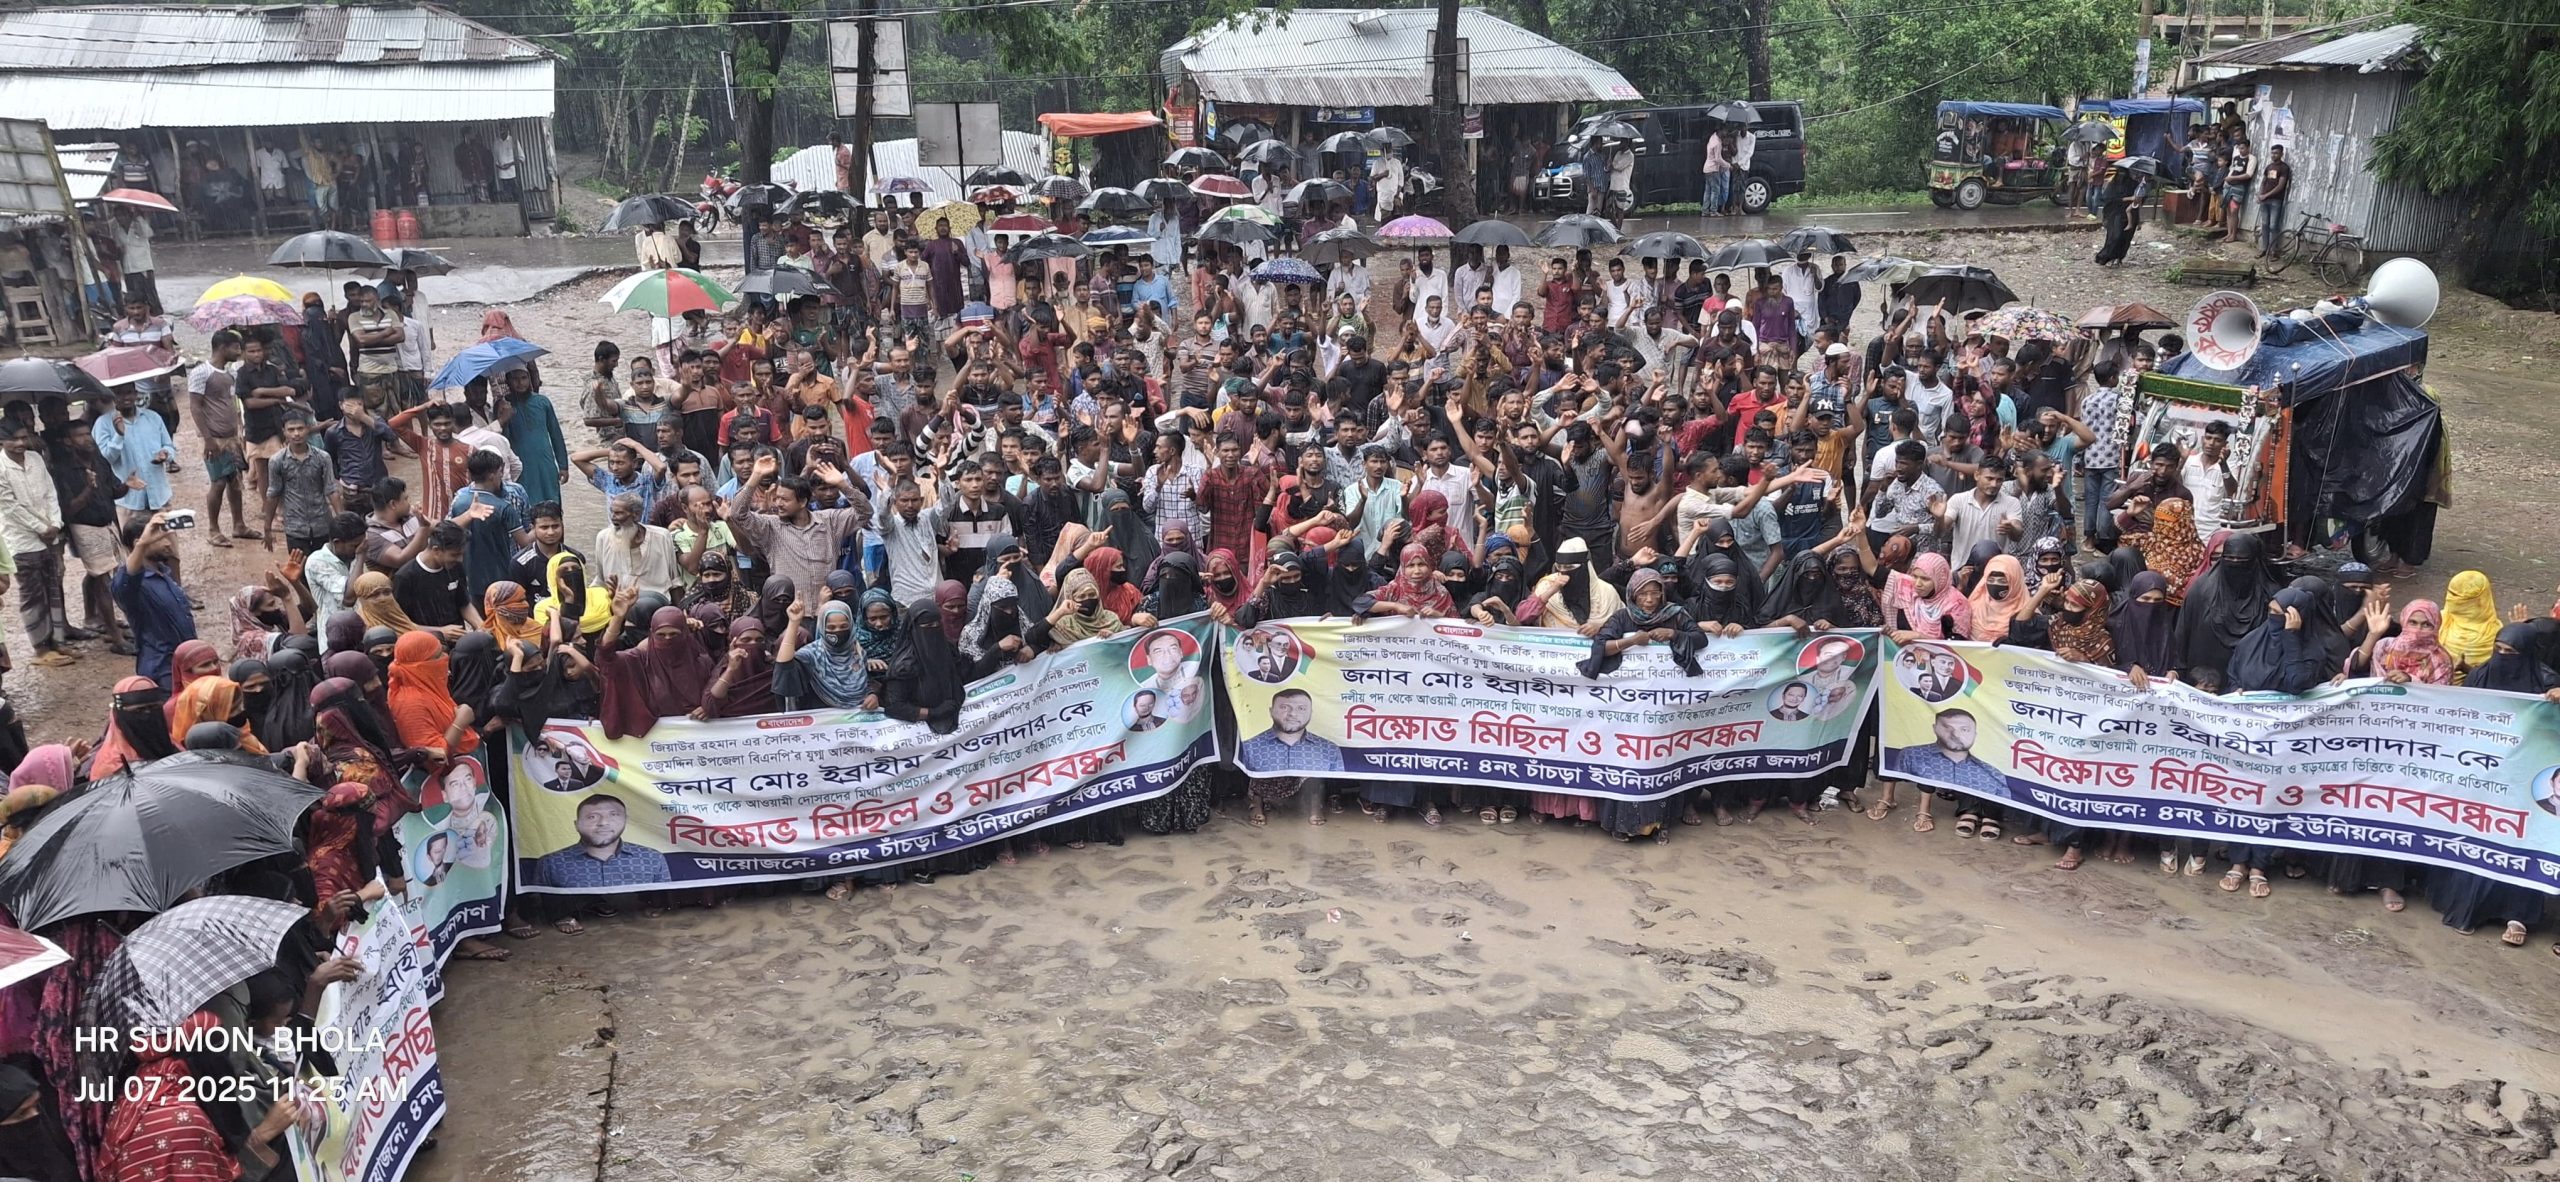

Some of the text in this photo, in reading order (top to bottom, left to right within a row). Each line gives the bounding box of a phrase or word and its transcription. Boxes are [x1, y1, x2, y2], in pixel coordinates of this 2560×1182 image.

[1381, 648, 1421, 661] উপজেলা
[1384, 635, 1416, 645] রহমান
[1420, 638, 1437, 647] এর
[1439, 637, 1473, 653] সৈনিক,
[650, 740, 695, 753] জিয়াউর
[700, 739, 737, 750] রহমান
[742, 737, 761, 747] এর
[764, 732, 806, 745] সৈনিক,
[835, 726, 873, 740] নির্ভীক,
[1067, 661, 1088, 676] কর্মী
[1340, 667, 1413, 686] জনাব
[1422, 671, 1473, 689] মোঃ
[1482, 672, 1579, 698] ইব্রাহীম
[1341, 689, 1365, 703] দলীয়
[1369, 693, 1385, 703] পদ
[1388, 692, 1414, 704] থেকে
[1415, 692, 1458, 707] আওয়ামী
[1461, 697, 1508, 711] দোসরদের
[1511, 699, 1536, 714] মিথ্যা
[1539, 702, 1582, 718] অপপ্রচার
[1586, 710, 1594, 718] ও
[2004, 679, 2051, 694] তজুমদ্দিন
[2055, 685, 2100, 704] উপজেলা
[2233, 717, 2241, 727] ও
[2308, 714, 2354, 728] ইউনিয়ন
[2359, 713, 2417, 730] বিএনপি'র
[2421, 722, 2466, 736] সাধারণ
[2469, 727, 2521, 746] সম্পাদক
[2013, 665, 2055, 680] জিয়াউর
[2059, 675, 2095, 688] রহমান
[2099, 683, 2118, 692] এর
[2370, 701, 2429, 714] দুঃসময়ের
[2485, 712, 2514, 726] কর্মী
[642, 756, 694, 773] তজুমদ্দিন
[697, 754, 745, 767] উপজেলা
[806, 749, 825, 763] যুগ্ম
[880, 744, 889, 752] ও
[893, 739, 915, 751] ৪নং
[1060, 677, 1100, 693] সম্পাদক
[652, 700, 1095, 796] জনাব মোঃ ইব্রাহীম হাওলাদার-কে
[1344, 704, 1764, 761] বিক্ষোভ মিছিল ও মানববন্ধন
[2007, 722, 2034, 739] দলীয়
[2038, 730, 2055, 742] পদ
[2058, 734, 2086, 749] থেকে
[2090, 738, 2138, 753] আওয়ামী
[2142, 743, 2197, 760] দোসরদের
[2232, 759, 2283, 775] অপপ্রচার
[2288, 764, 2297, 774] ও
[2301, 761, 2349, 776] ষড়যন্ত্রের
[2352, 757, 2396, 773] ভিত্তিতে
[2399, 762, 2456, 785] বহিষ্কারের
[2457, 774, 2510, 795] প্রতিবাদে
[2009, 699, 2504, 771] জনাব মোঃ ইব্রাহীম হাওলাদার-কে
[666, 739, 1127, 848] বিক্ষোভ মিছিল ও মানববন্ধন
[692, 803, 709, 815] পদ
[713, 799, 743, 814] থেকে
[744, 794, 793, 809] আওয়ামী
[797, 790, 850, 806] দোসরদের
[885, 773, 930, 792] অপপ্রচার
[934, 771, 943, 781] ও
[1066, 722, 1108, 743] প্রতিবাদে
[1478, 759, 1520, 777] ৪নং
[1524, 758, 1583, 785] চাঁচড়া
[1589, 764, 1684, 790] ইউনিয়নের
[1687, 754, 1761, 776] সর্বস্তরের
[2010, 738, 2530, 839] বিক্ষোভ মিছিল ও মানববন্ধন
[828, 847, 873, 865] ৪নং
[876, 831, 938, 857] চাঁচড়া
[944, 802, 1050, 842] ইউনিয়নের
[1055, 774, 1138, 807] সর্বস্তরের
[2158, 805, 2206, 826] ৪নং
[2212, 807, 2280, 835] চাঁচড়া
[2285, 814, 2416, 848] ইউনিয়নের
[2422, 836, 2532, 873] সর্বস্তরের
[410, 1079, 443, 1122] ৪নং
